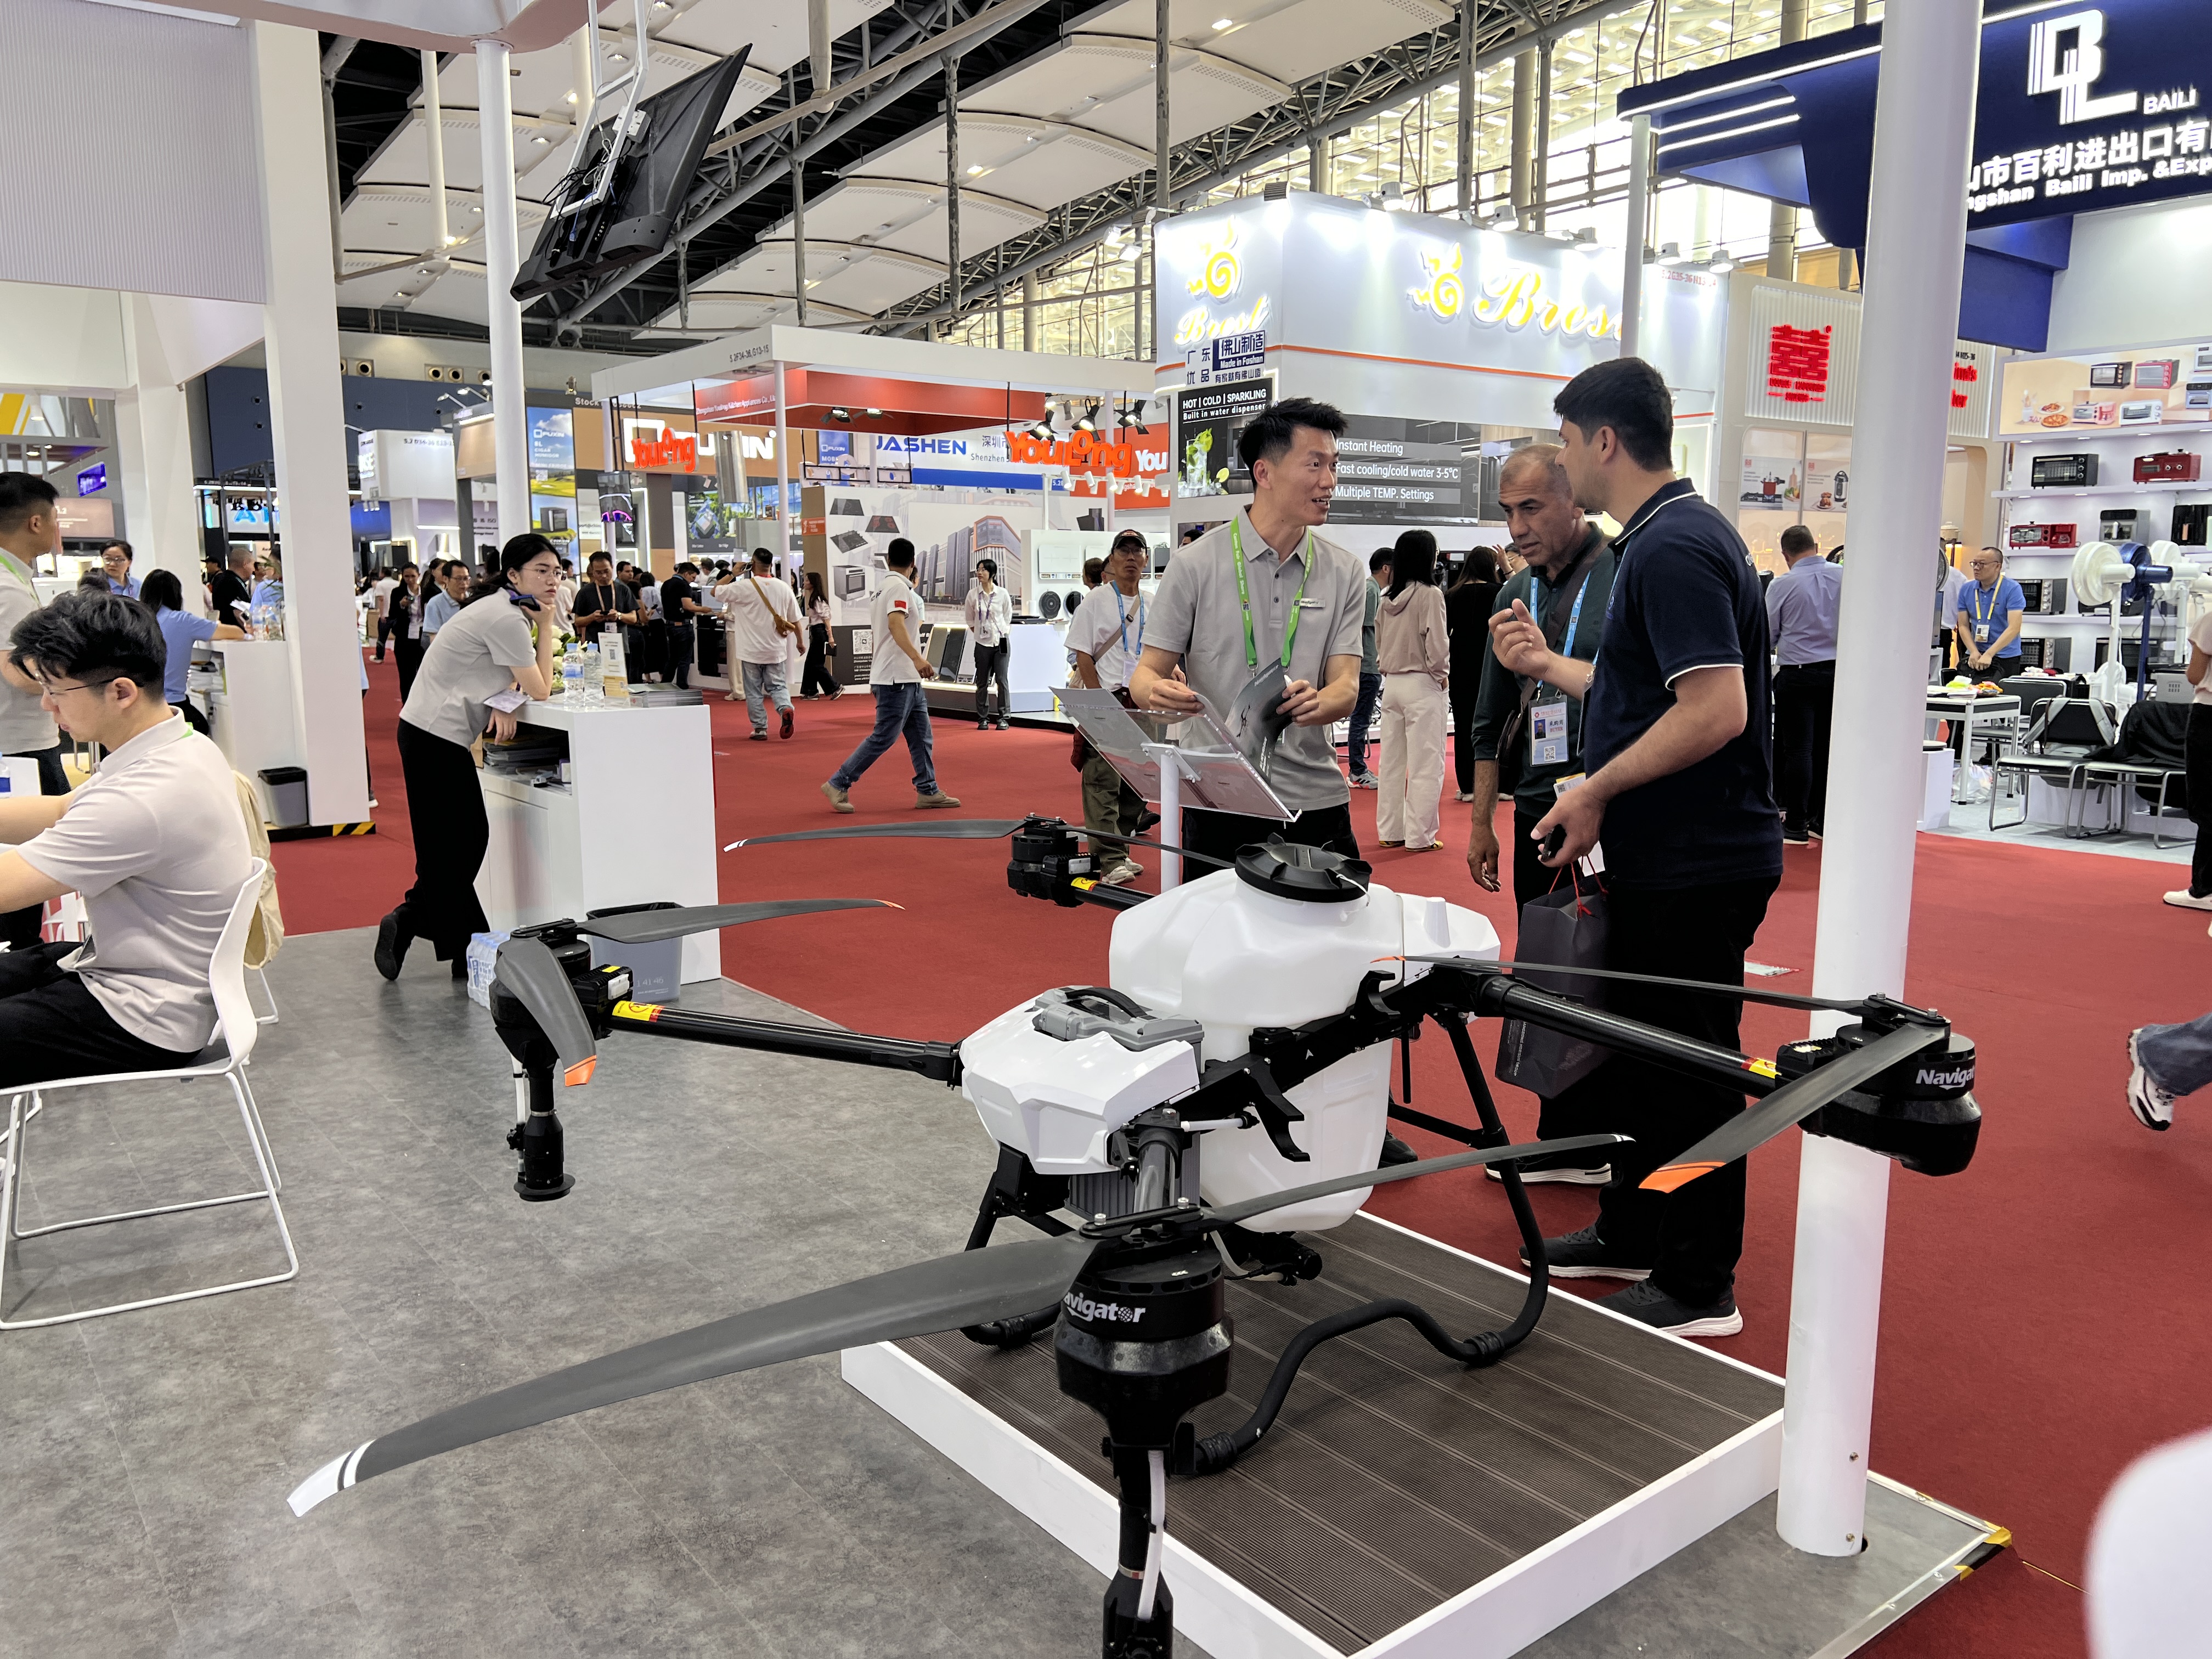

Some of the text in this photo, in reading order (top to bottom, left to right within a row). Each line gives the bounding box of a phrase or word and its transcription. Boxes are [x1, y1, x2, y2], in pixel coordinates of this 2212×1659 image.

[2143, 88, 2197, 115] BAILI
[1967, 119, 2212, 191] 市百利进出口有
[1967, 185, 2035, 213] ngshan
[2045, 173, 2094, 198] Baili
[2101, 167, 2149, 188] Imp.
[1221, 334, 1263, 357] 佛山制造
[1220, 355, 1263, 370] Made in Foshan
[1953, 362, 1978, 382] ina's
[1183, 388, 1266, 409] HOT COLD SPARKLING
[1183, 411, 1199, 420] Built
[1210, 408, 1229, 416] water
[1232, 403, 1266, 414] dispenser
[876, 435, 966, 455] JASHEN
[1336, 439, 1403, 456] Instant Heating
[970, 453, 1005, 462] Shenzhen
[1335, 462, 1355, 475] Fast
[1357, 464, 1409, 478] cooling/cold
[1410, 468, 1435, 478] water
[1335, 486, 1434, 502] Multiple TEMP. Settings
[1915, 1064, 1976, 1091] Navigat
[1063, 1291, 1146, 1322] avigator
